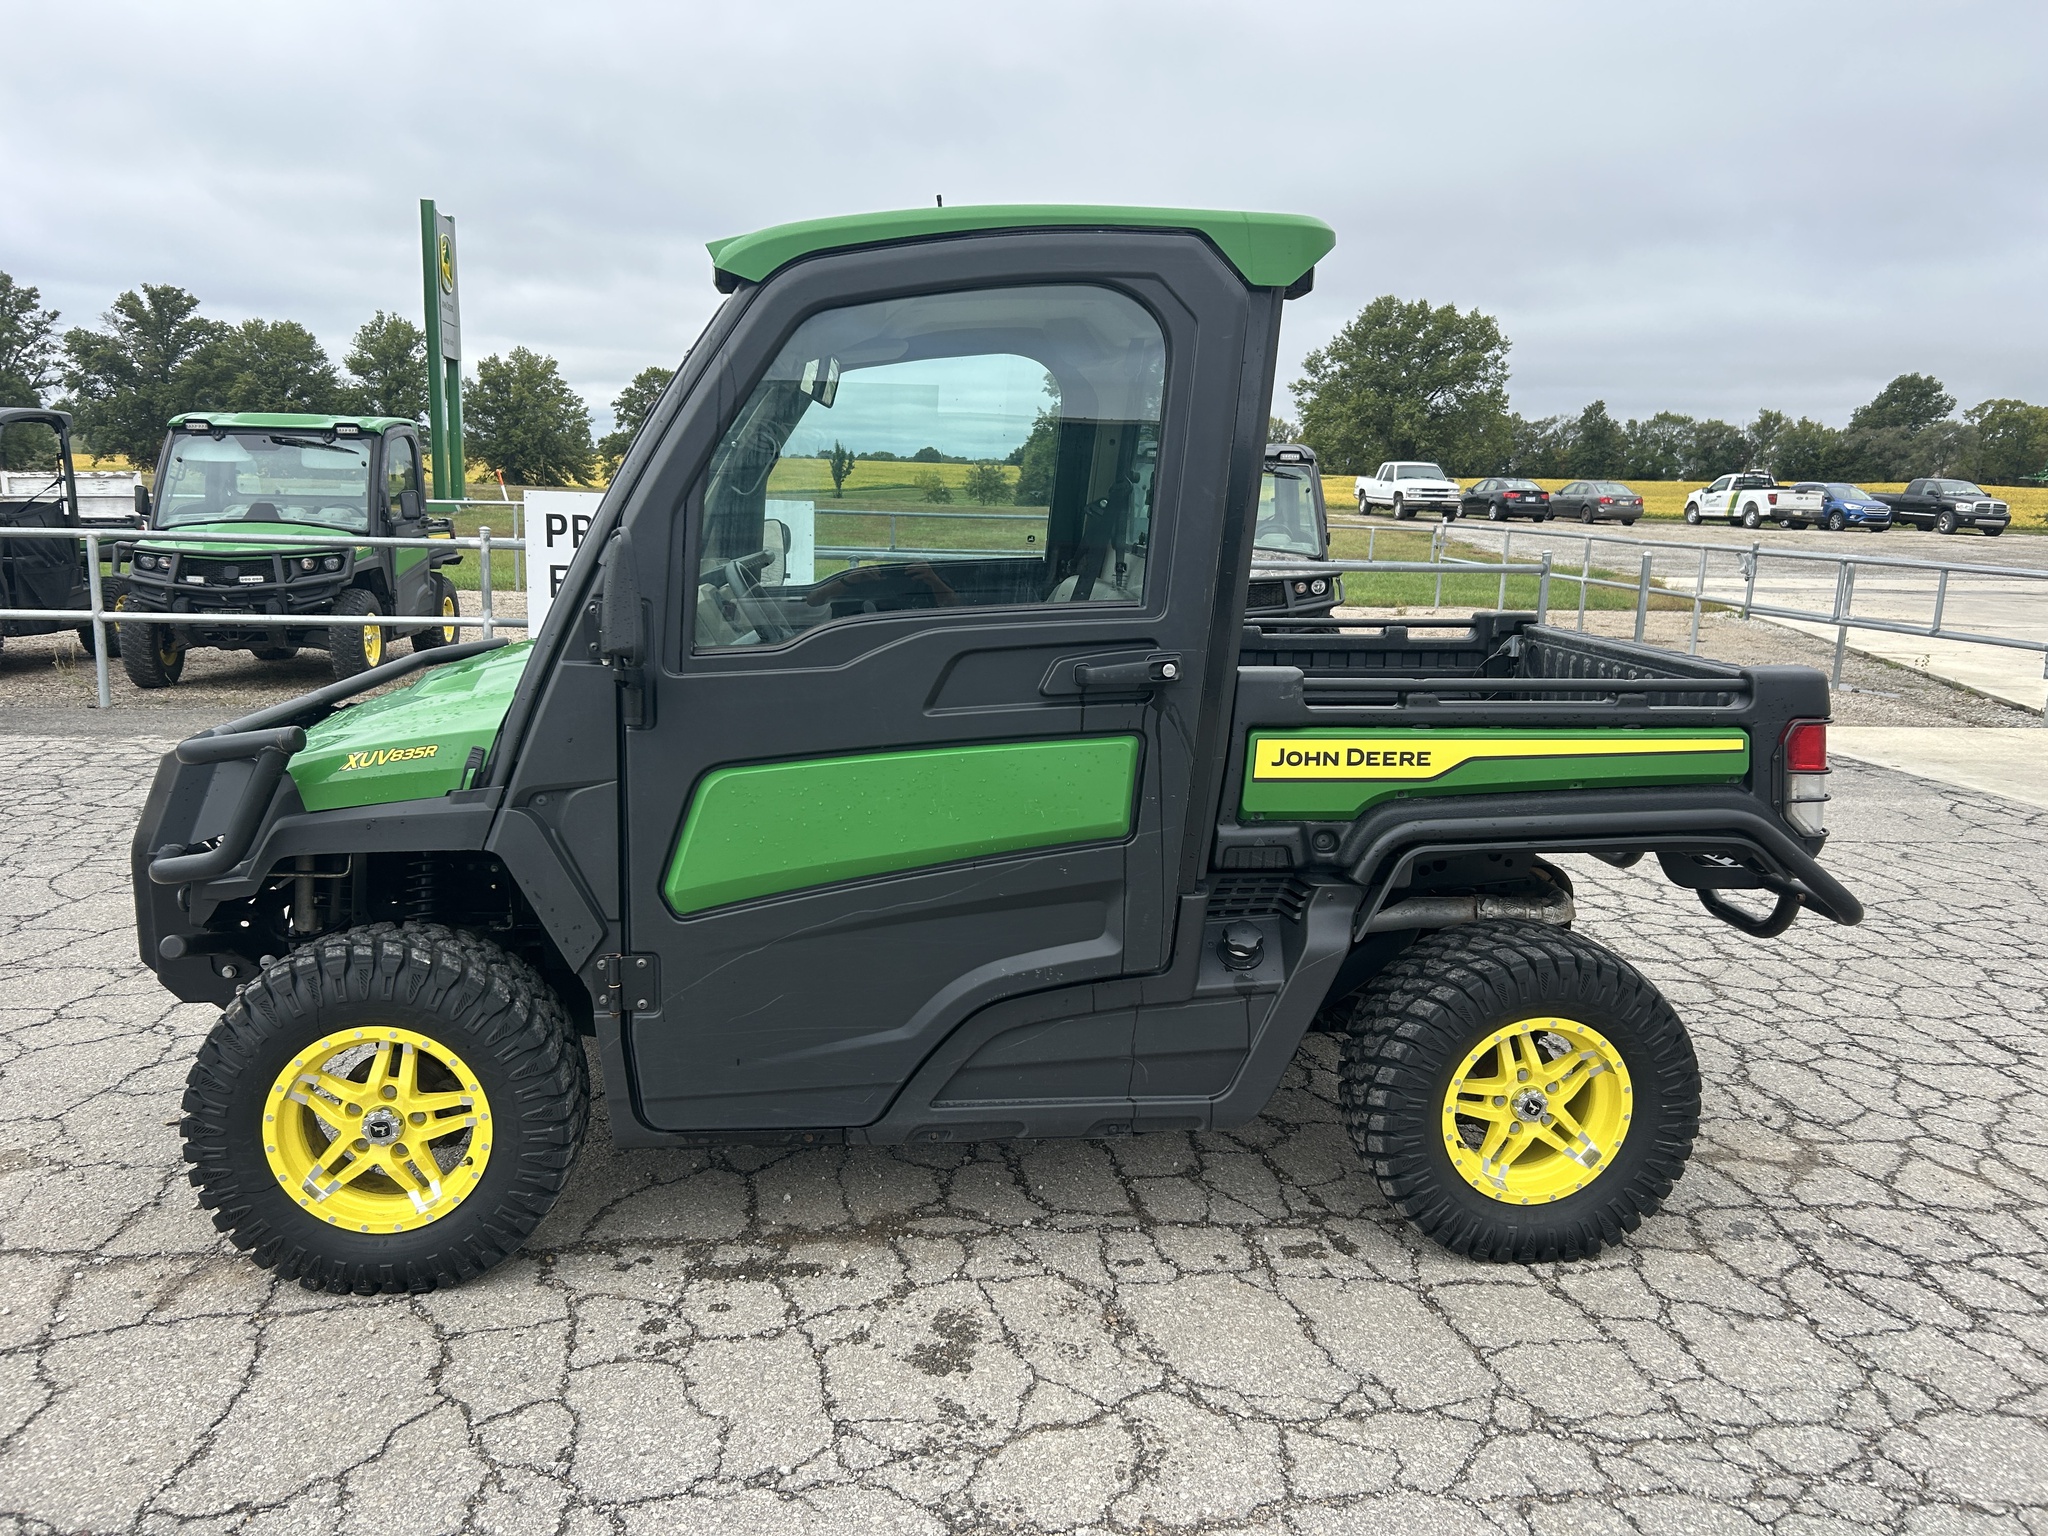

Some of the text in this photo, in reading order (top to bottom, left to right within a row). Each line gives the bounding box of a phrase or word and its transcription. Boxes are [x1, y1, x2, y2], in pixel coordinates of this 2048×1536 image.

[340, 745, 439, 771] XUV835R
[1271, 748, 1432, 767] JOHN DEERE
